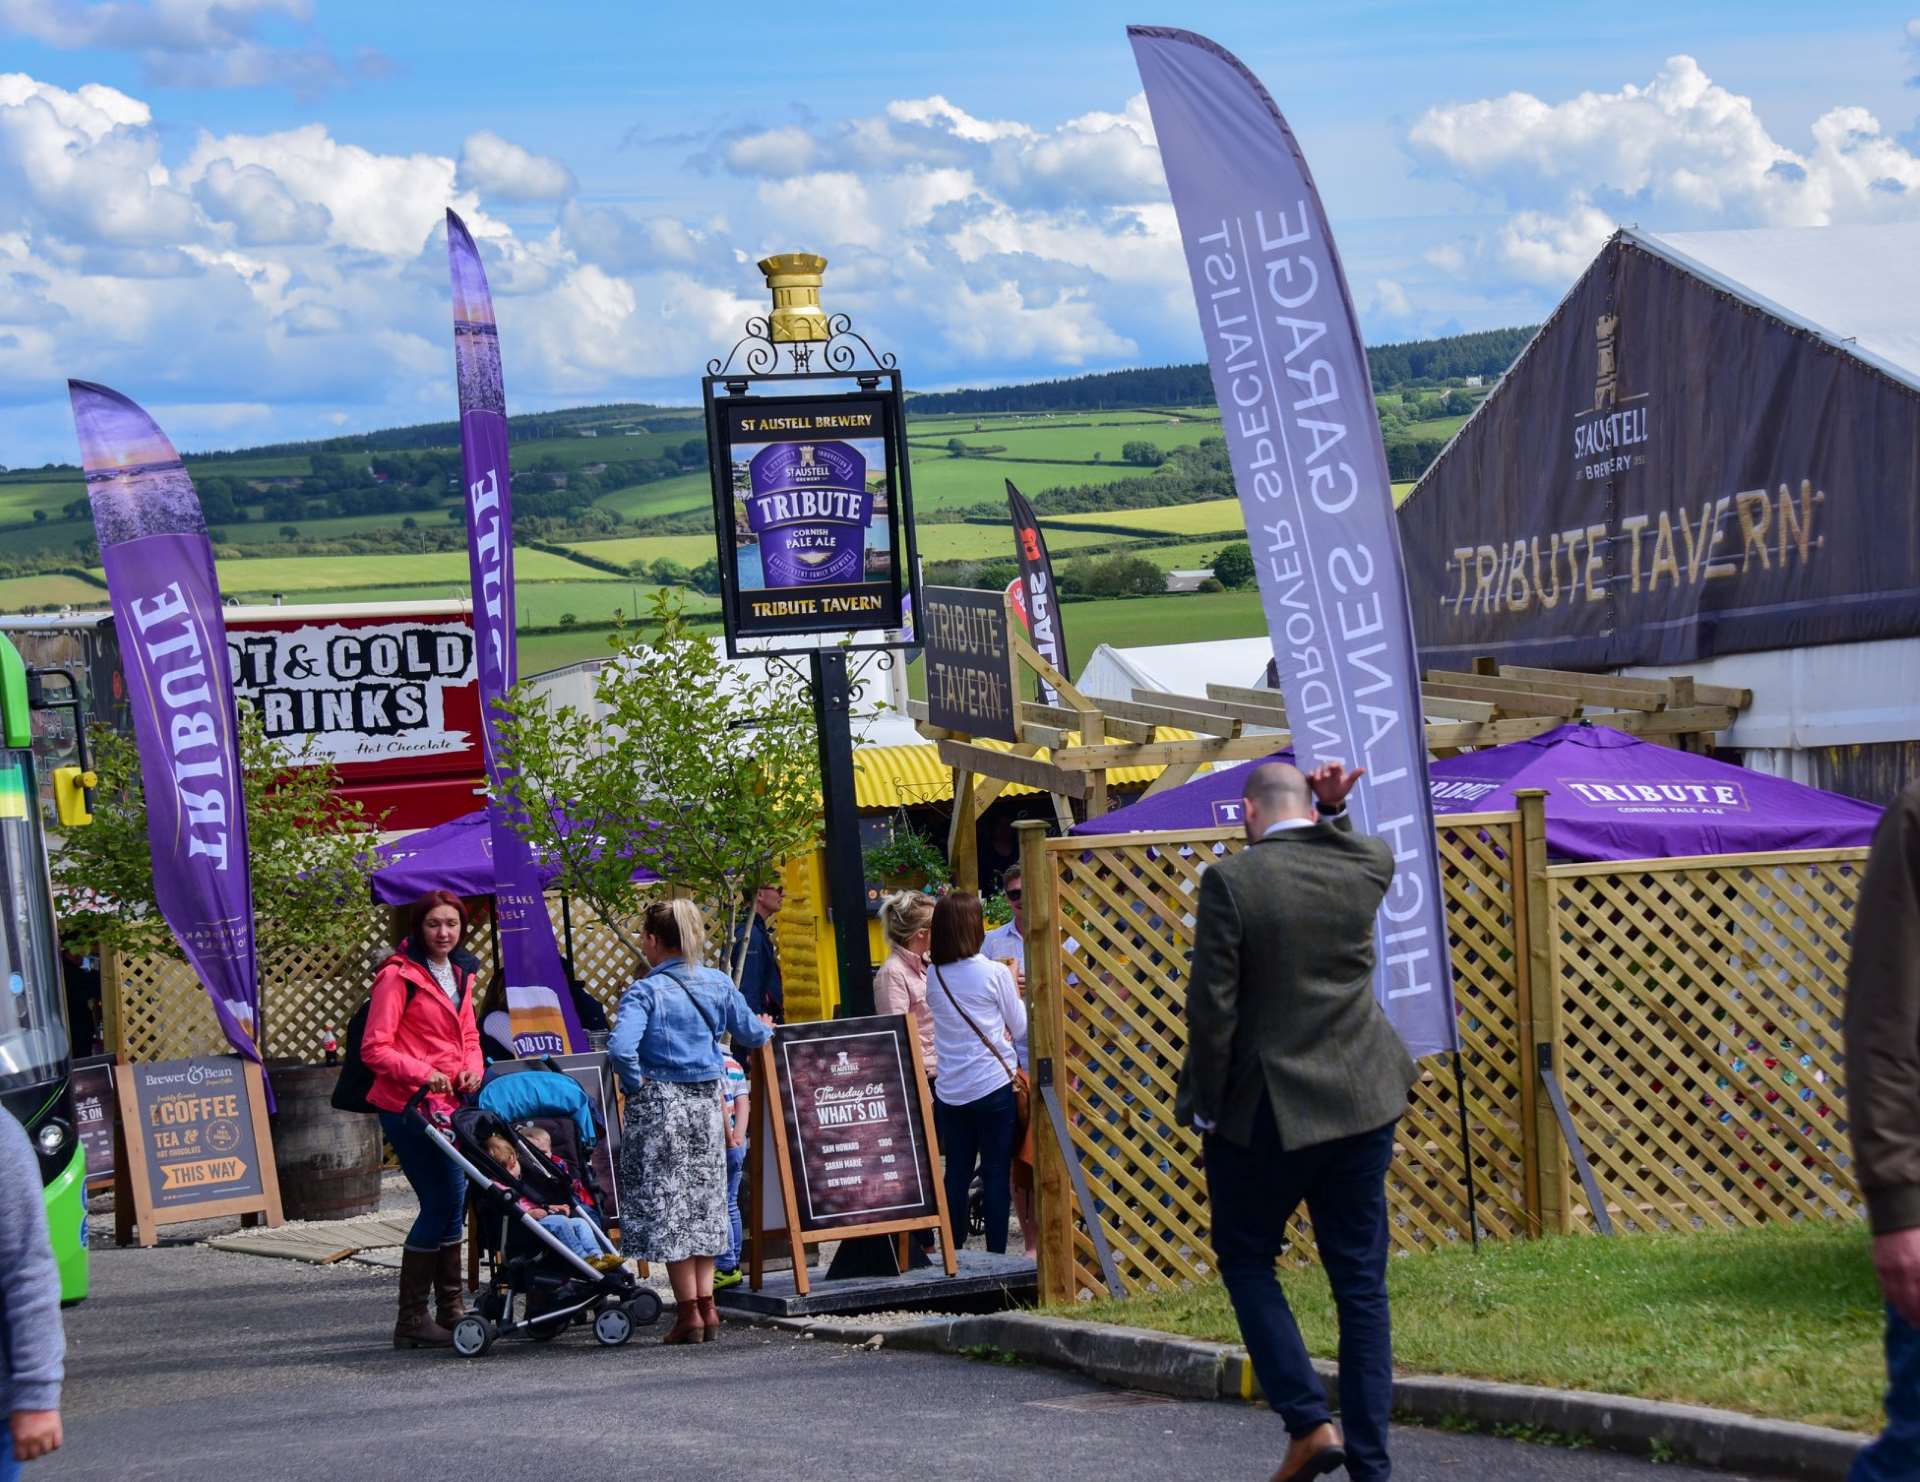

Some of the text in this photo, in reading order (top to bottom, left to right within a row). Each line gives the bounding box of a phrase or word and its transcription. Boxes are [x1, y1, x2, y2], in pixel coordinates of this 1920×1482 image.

[741, 414, 873, 431] ST AUSTELL BREWERY
[1585, 455, 1632, 480] BREWERY
[757, 491, 862, 524] TRIBUTE
[786, 537, 836, 549] PALE ALE
[793, 528, 829, 538] CORNISH
[1453, 478, 1812, 615] TRIBUTE TAVERN
[752, 596, 882, 617] TRIBUTE TAVERN
[929, 602, 1001, 657] TRIBUTE
[333, 635, 465, 677] COLD
[935, 663, 1002, 720] TAVERN
[250, 685, 425, 732] RINKS
[387, 736, 452, 752] Chocolate
[1569, 783, 1739, 805] TRIBUTE
[513, 1035, 563, 1056] TRIBUTE
[145, 1074, 186, 1086] Brewer
[204, 1068, 233, 1079] Bean
[815, 1082, 884, 1103] Thursday 6th
[161, 1094, 239, 1125] COFFEE
[816, 1100, 887, 1124] WHAT'S ON
[154, 1132, 180, 1148] TEA
[172, 1161, 236, 1184] THIS WAY
